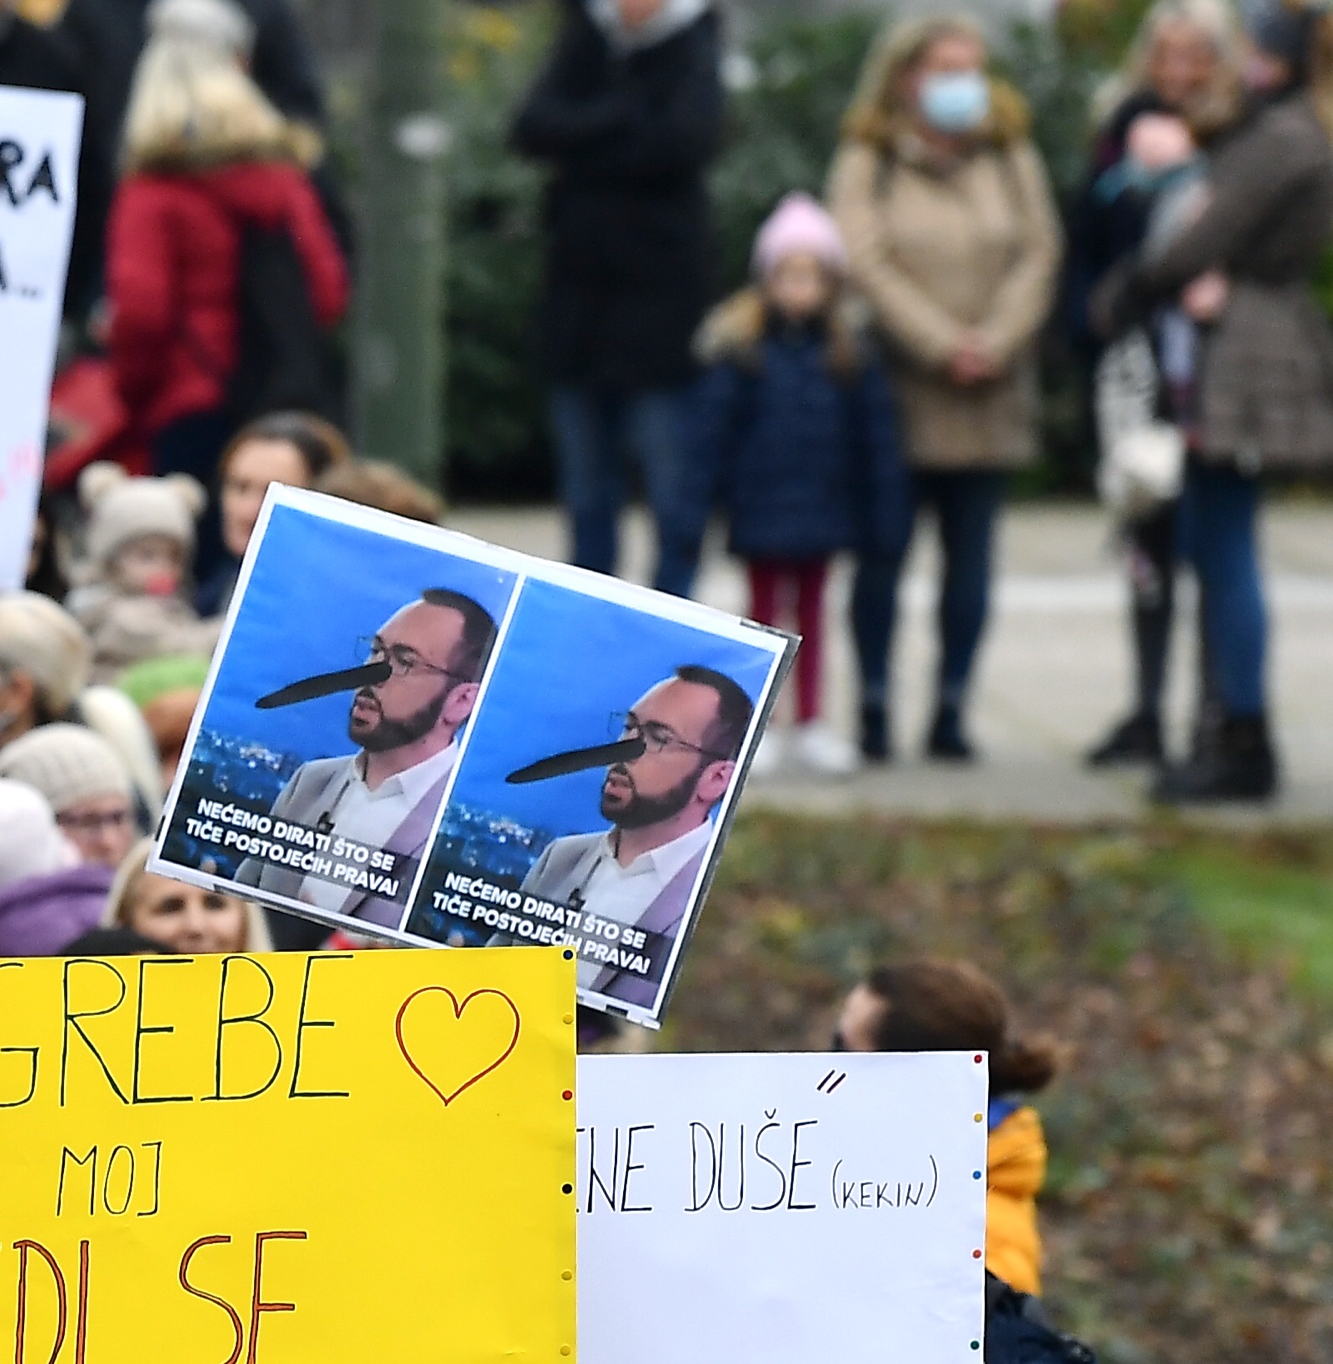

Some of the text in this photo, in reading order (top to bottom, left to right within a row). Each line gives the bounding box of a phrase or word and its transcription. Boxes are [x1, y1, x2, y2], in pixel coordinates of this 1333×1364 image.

[186, 818, 400, 897] TIČE POSTOJEĆIH PRAVA!
[197, 798, 395, 871] NEĆEMO DIRATI ŠTO SE
[433, 892, 471, 918] TIČE
[583, 939, 651, 974] PRAVA!
[445, 872, 647, 950] NEĆEMO DIRATI ŠTO SE
[57, 1141, 164, 1218] MOJ
[577, 1125, 654, 1213] NE
[831, 1155, 938, 1209] (KEKIN)
